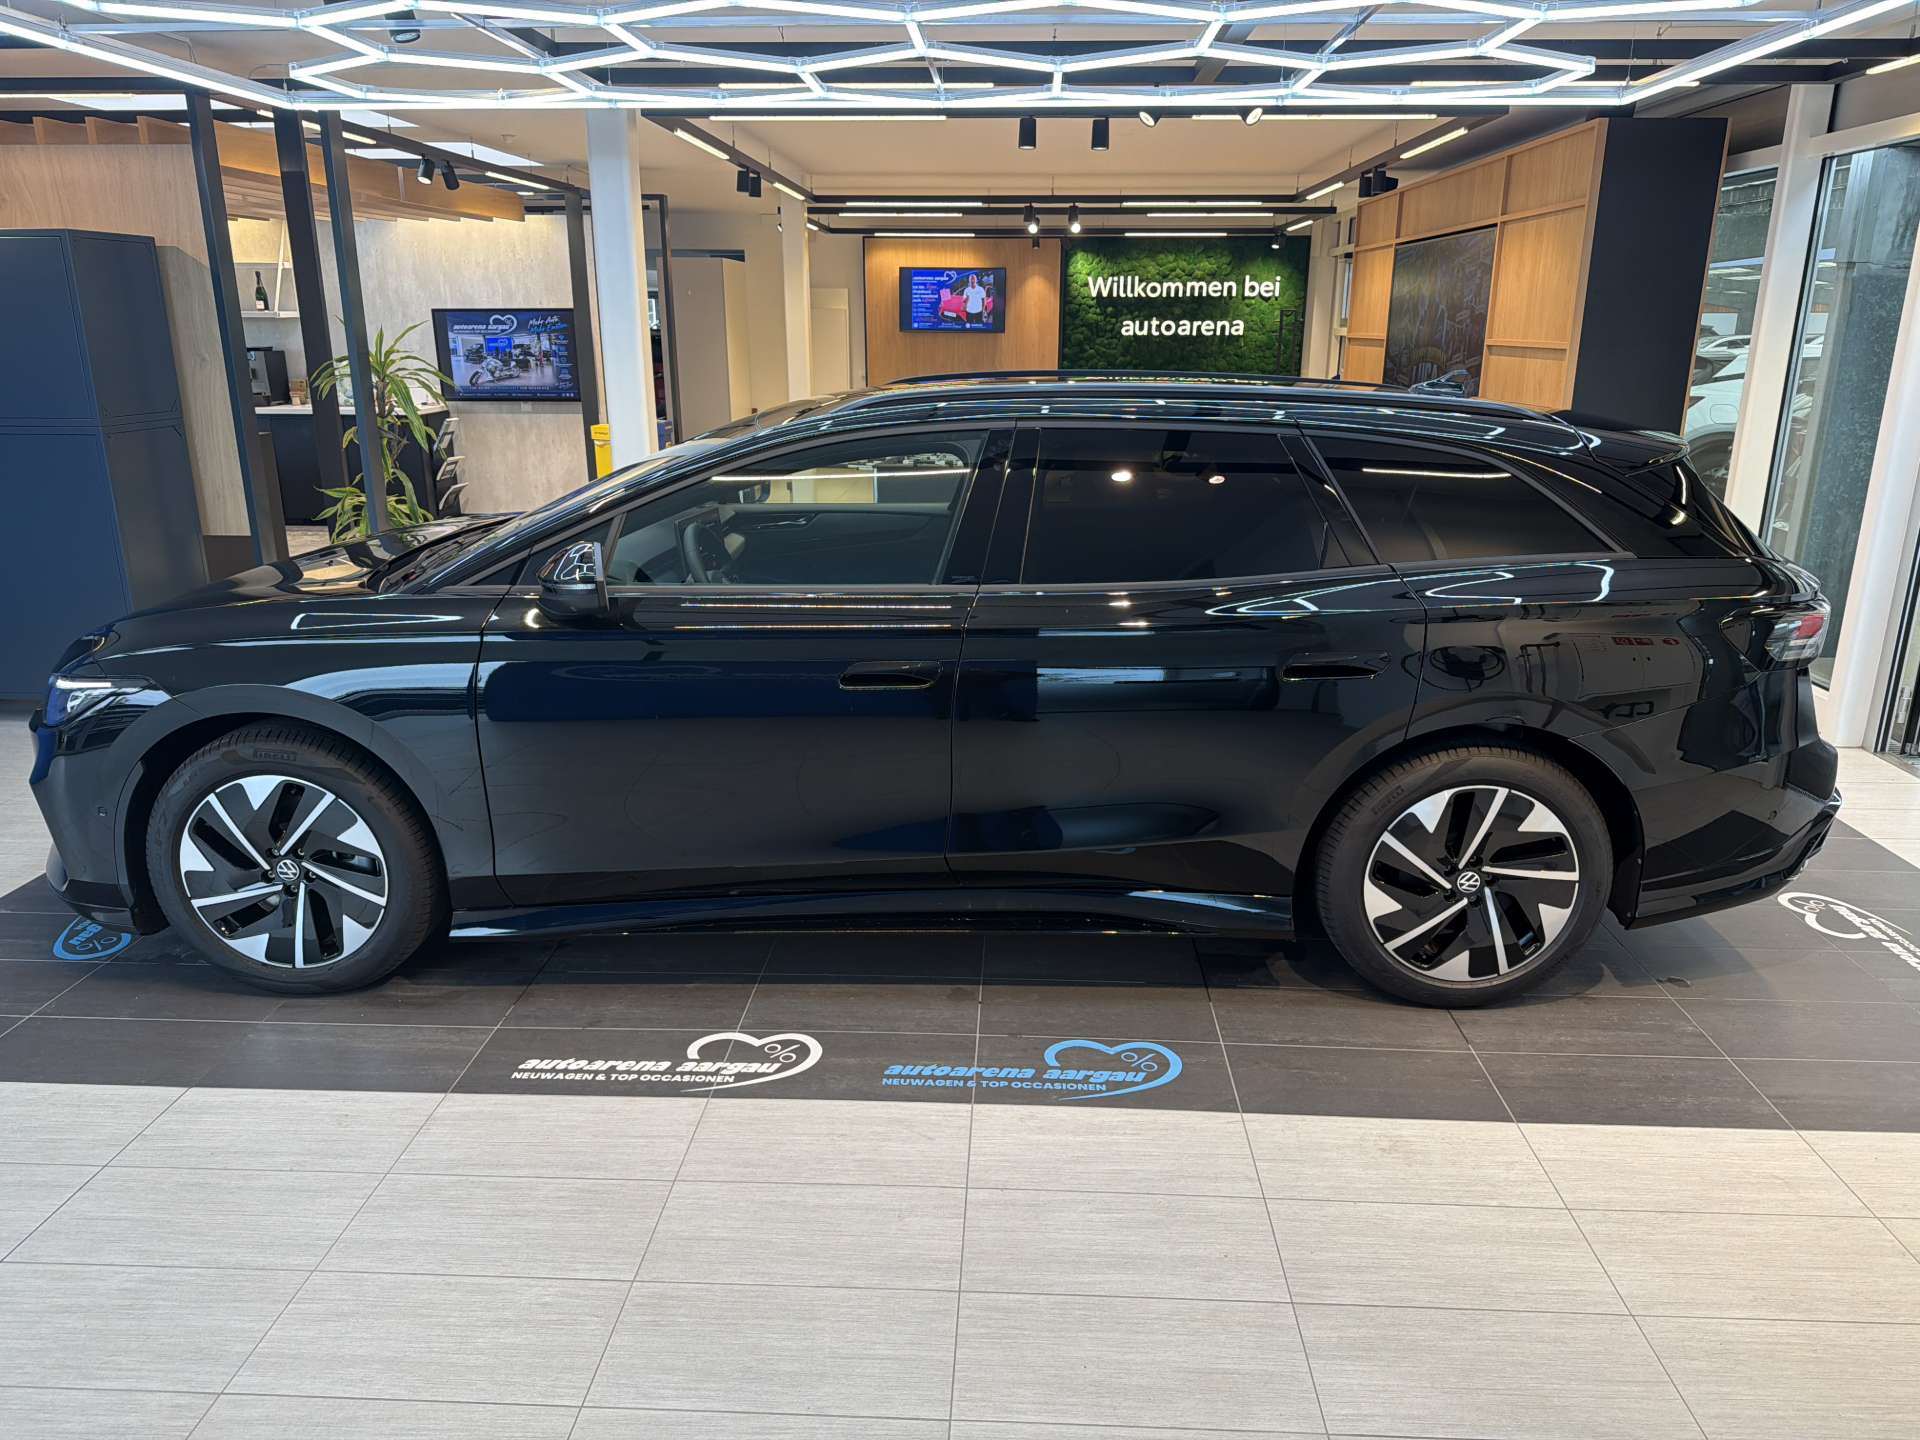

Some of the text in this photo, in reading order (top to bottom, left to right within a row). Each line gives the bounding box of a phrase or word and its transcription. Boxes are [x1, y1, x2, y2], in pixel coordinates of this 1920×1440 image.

[1088, 275, 1281, 298] Willkommen bei
[1120, 316, 1245, 337] autoarena
[518, 1055, 782, 1075] autoarena aargau
[884, 1063, 1147, 1084] autoarena aargau
[511, 1071, 735, 1083] NEUWAGEN & TOP OCCASIONEN
[882, 1078, 964, 1088] NEUWAGEN
[980, 1080, 1009, 1089] TOP
[1011, 1081, 1107, 1091] OCCASIONEN
